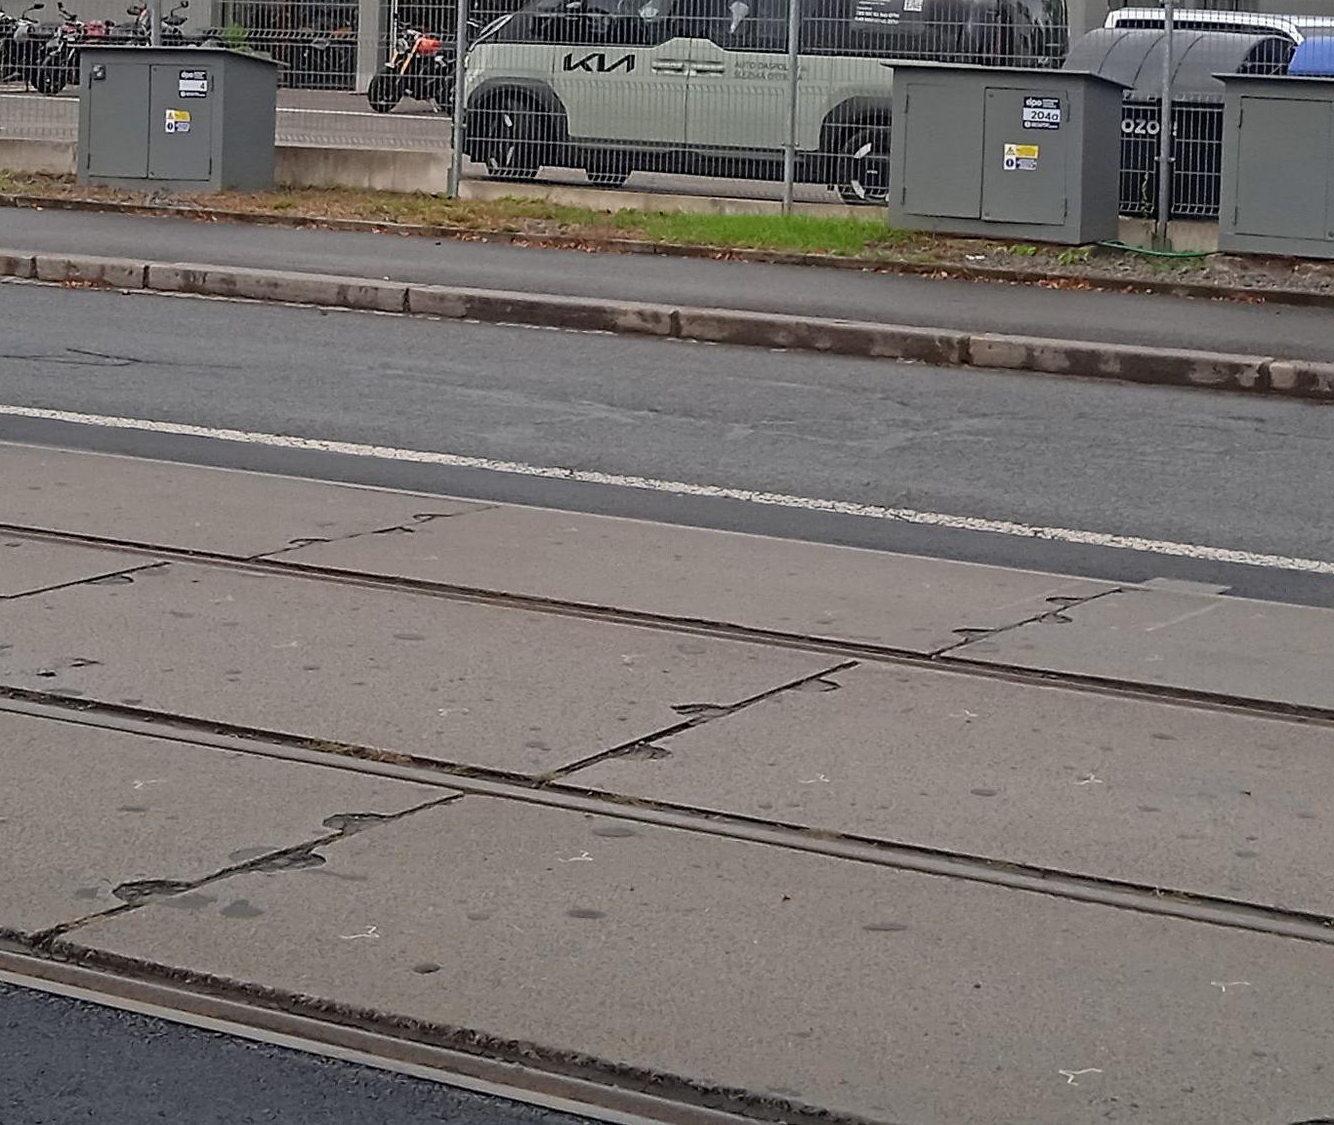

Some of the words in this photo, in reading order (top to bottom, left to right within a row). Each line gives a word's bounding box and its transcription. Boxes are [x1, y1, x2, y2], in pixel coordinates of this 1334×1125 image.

[563, 53, 636, 73] KIA
[200, 82, 206, 90] 4
[1025, 98, 1043, 108] dpo
[1031, 110, 1059, 121] 204a
